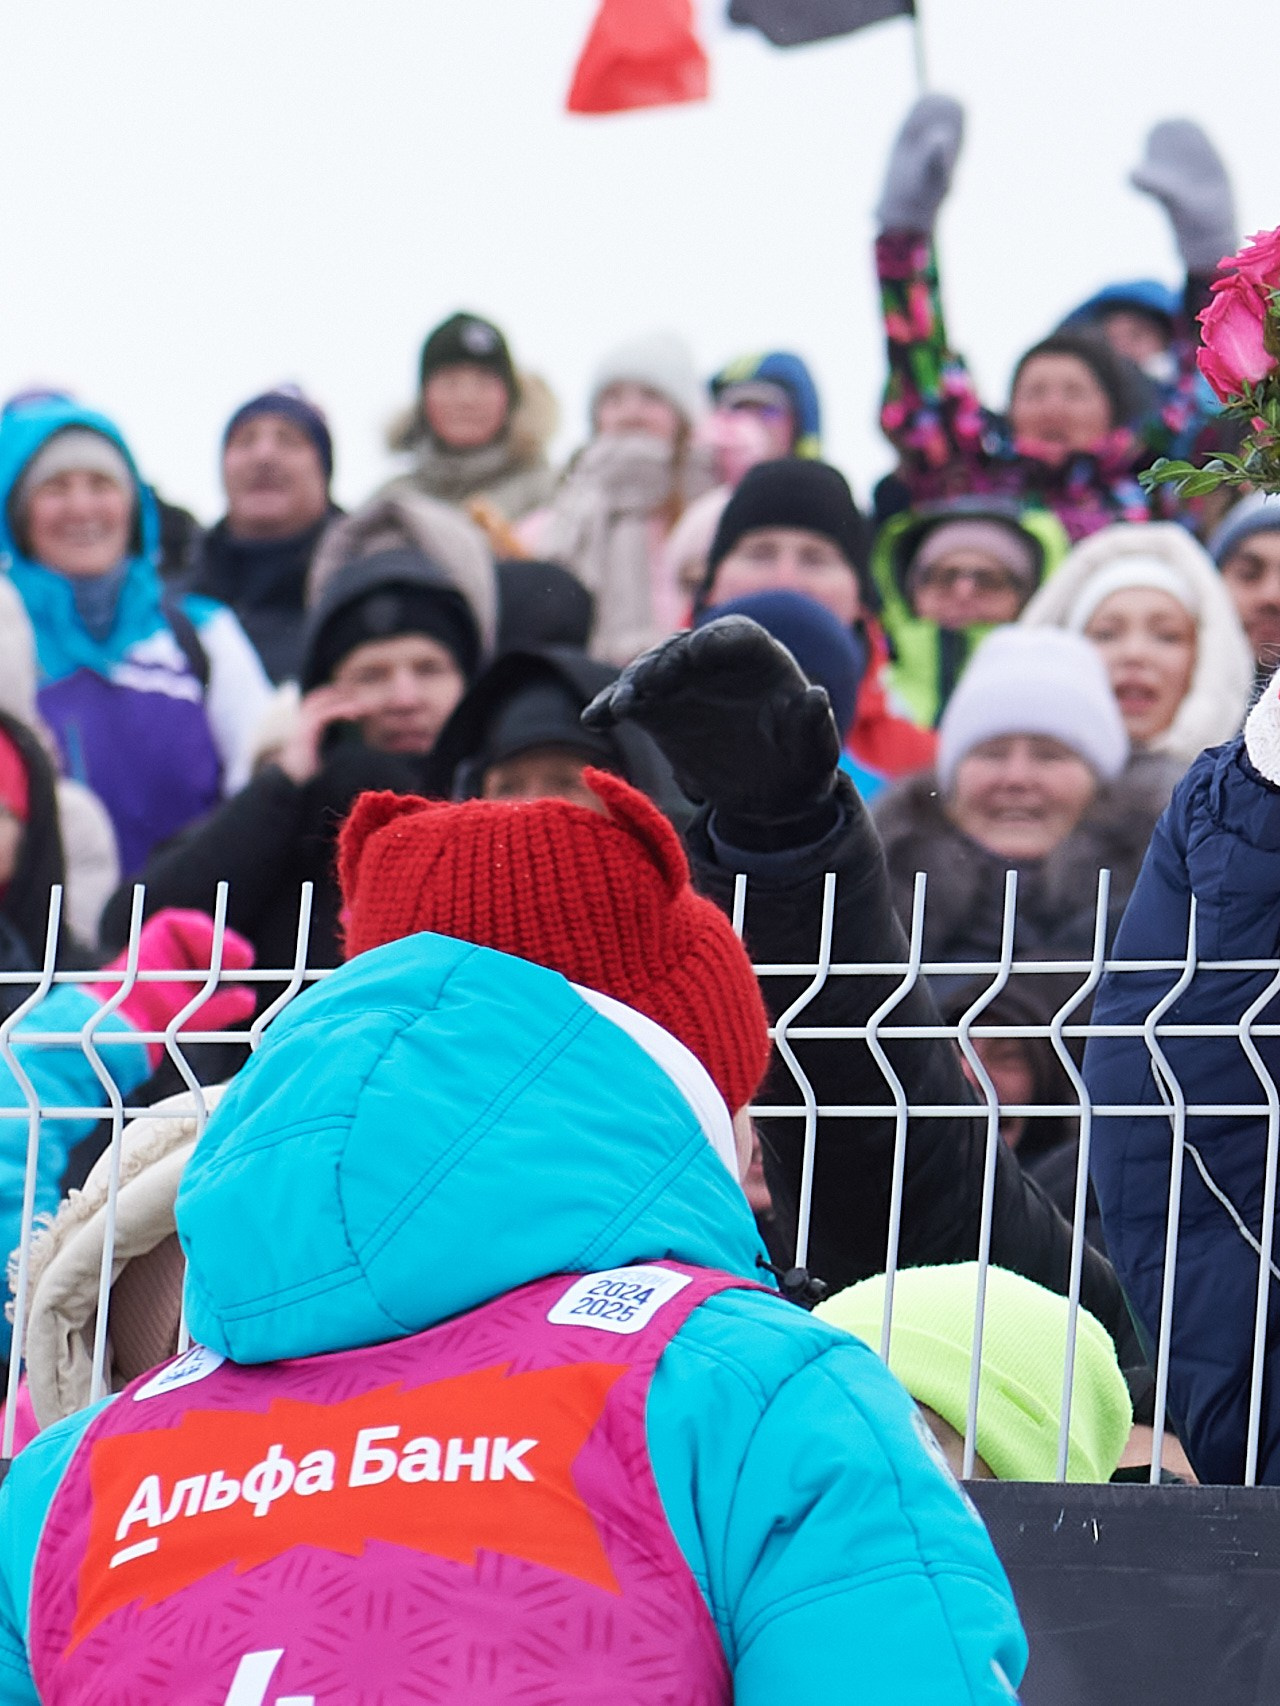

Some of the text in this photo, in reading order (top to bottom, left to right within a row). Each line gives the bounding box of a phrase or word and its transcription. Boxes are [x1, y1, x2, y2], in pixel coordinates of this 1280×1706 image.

[587, 1279, 656, 1305] 2024
[569, 1297, 639, 1322] 2025
[113, 1425, 539, 1544] Альфа Банк
